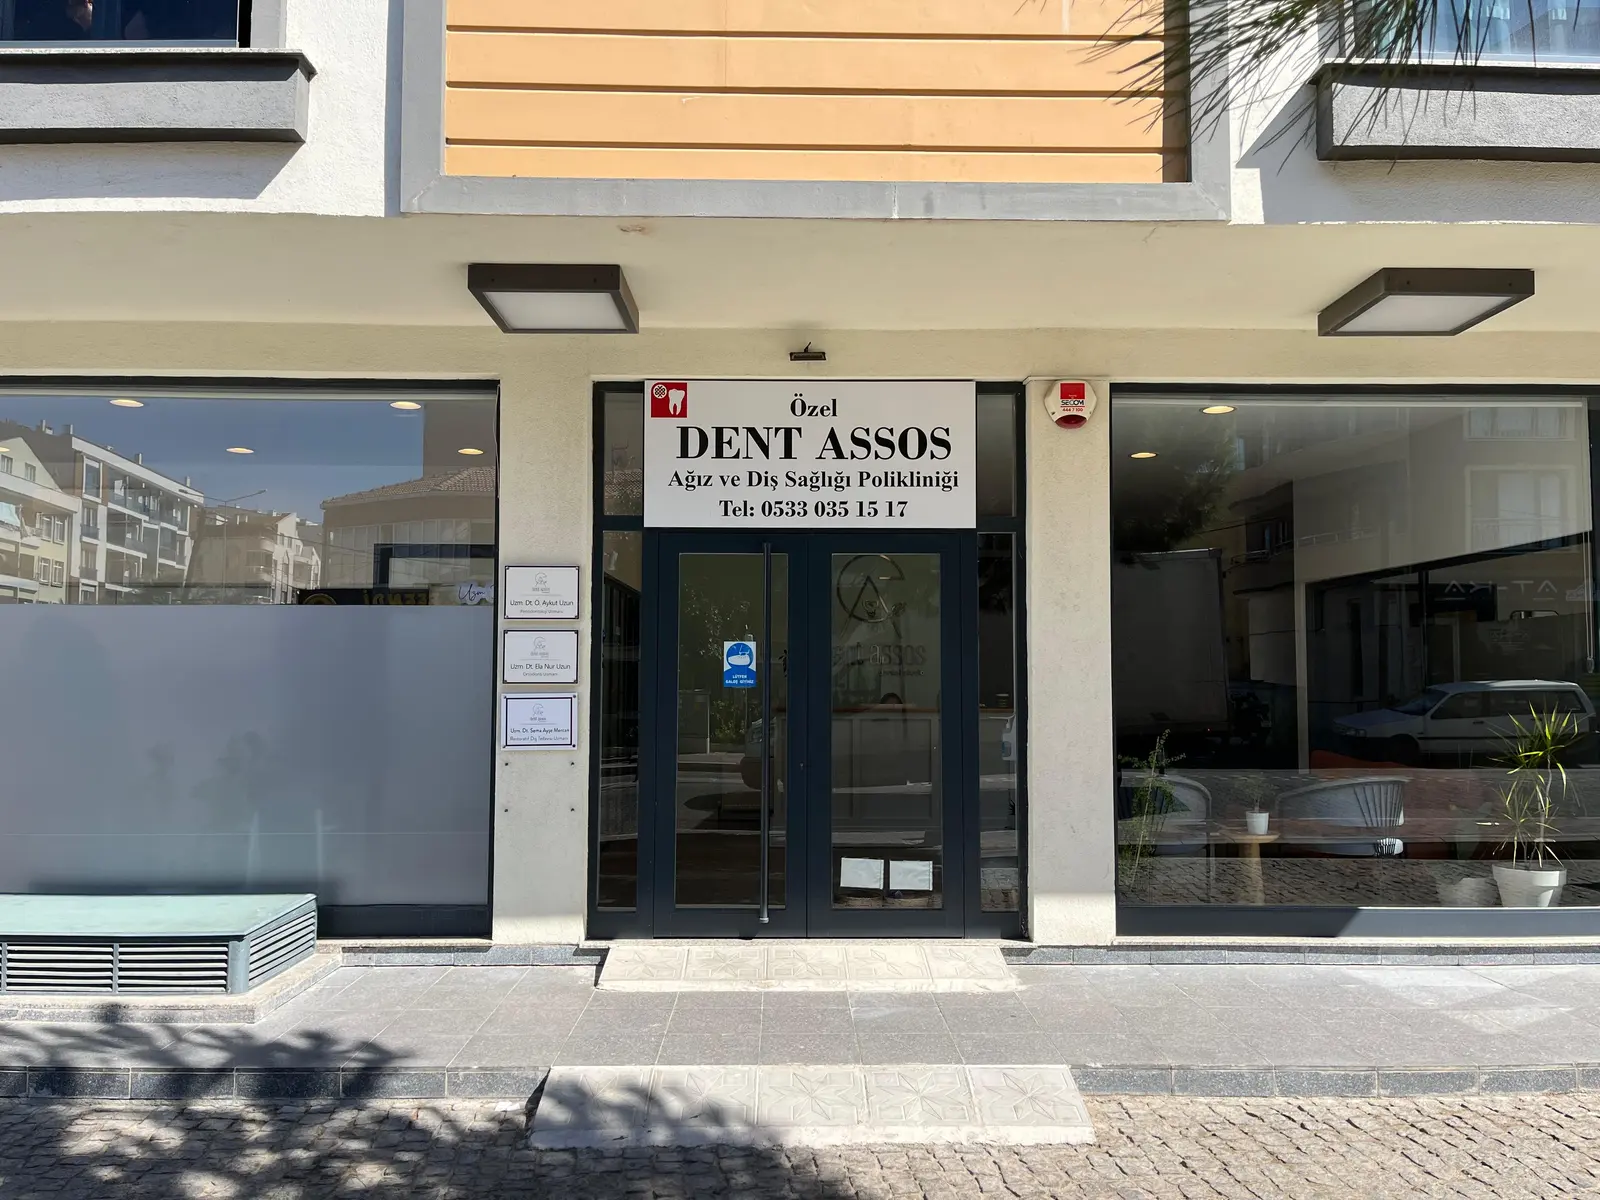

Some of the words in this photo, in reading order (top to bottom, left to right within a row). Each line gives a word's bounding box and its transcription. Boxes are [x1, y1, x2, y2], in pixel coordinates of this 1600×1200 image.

[790, 393, 838, 417] Özel
[676, 426, 802, 460] DENT
[815, 426, 952, 461] ASSOS
[668, 470, 713, 492] Ağız
[719, 474, 740, 487] ve
[746, 470, 778, 491] Diş
[785, 470, 851, 492] Sağlığı
[857, 470, 959, 492] Polikliniği
[719, 500, 755, 517] Tel:
[761, 500, 808, 517] 0533
[814, 500, 849, 517] 035
[856, 500, 878, 517] 15
[885, 500, 908, 517] 17
